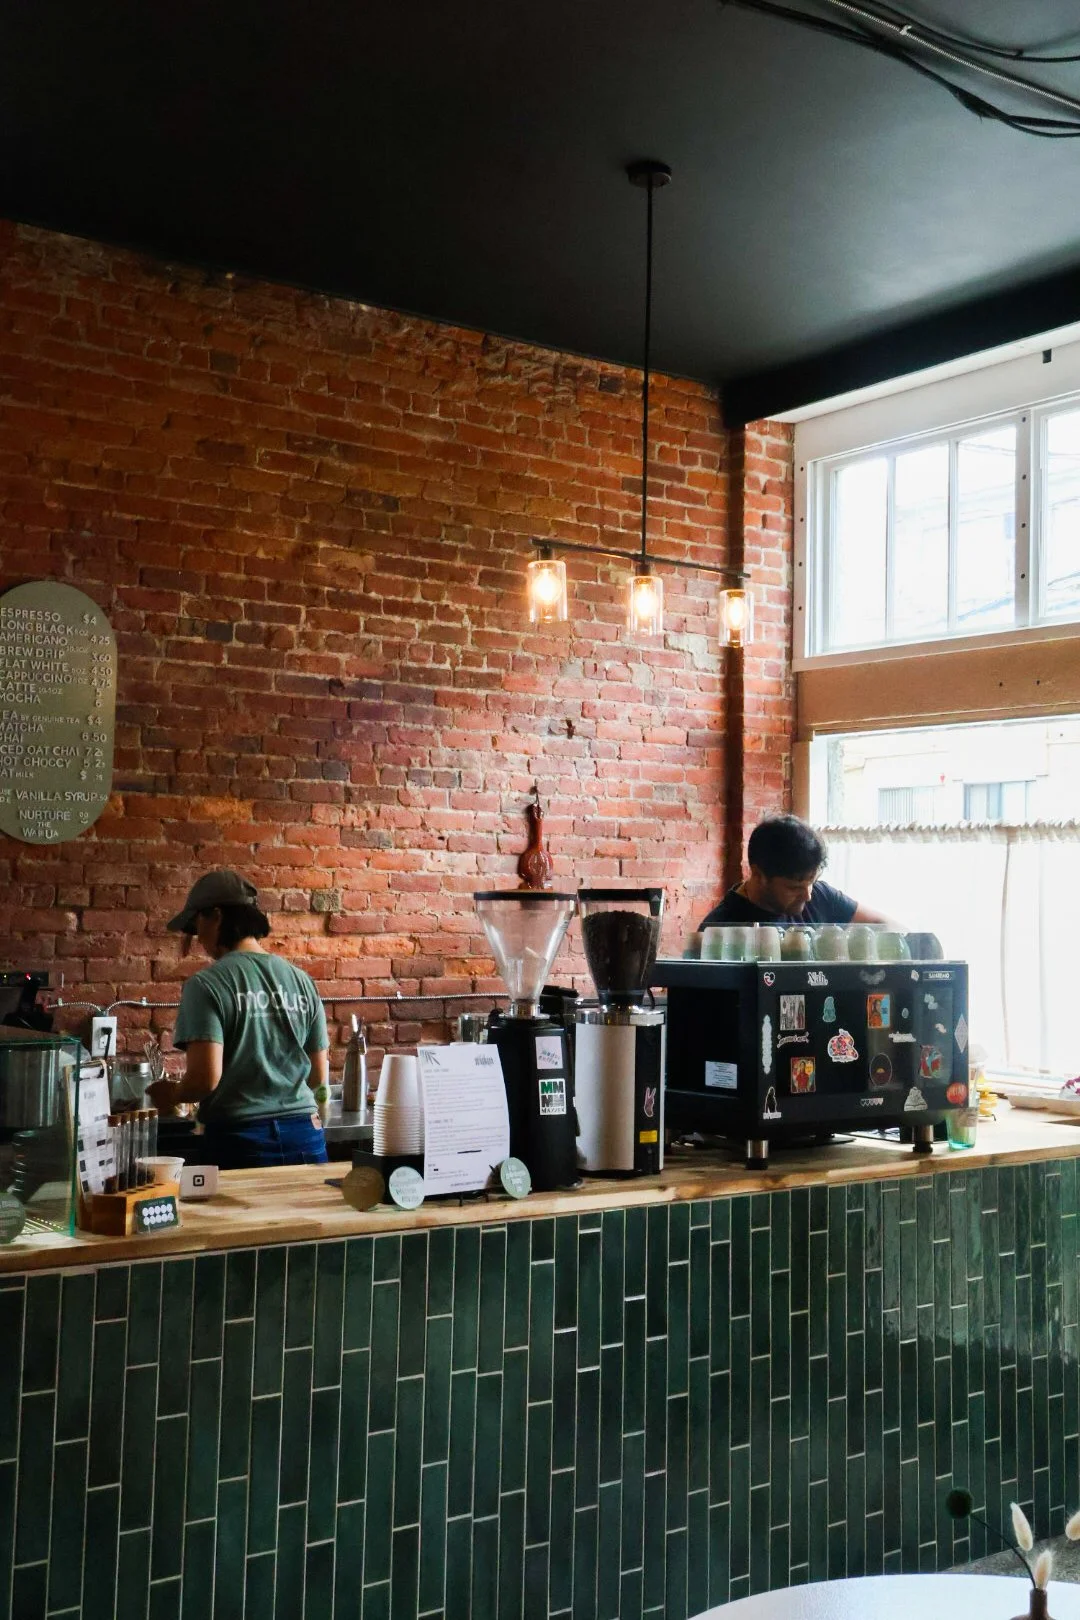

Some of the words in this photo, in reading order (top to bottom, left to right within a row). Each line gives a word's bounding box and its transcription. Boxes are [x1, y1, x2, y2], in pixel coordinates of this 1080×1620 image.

[0, 607, 61, 622] ESPRESSO
[1, 620, 33, 631] LONG
[36, 622, 73, 636] BLACK
[0, 632, 68, 646] AMERICANO
[0, 646, 33, 657] BREW
[36, 648, 65, 659] DRIP
[30, 660, 69, 672] WHITE
[0, 681, 37, 693] LATTE
[27, 745, 50, 756] OAT
[52, 746, 80, 757] CHAI
[15, 788, 61, 801] VANILLA
[64, 791, 98, 802] SYRUP
[19, 809, 71, 821] NURTURE
